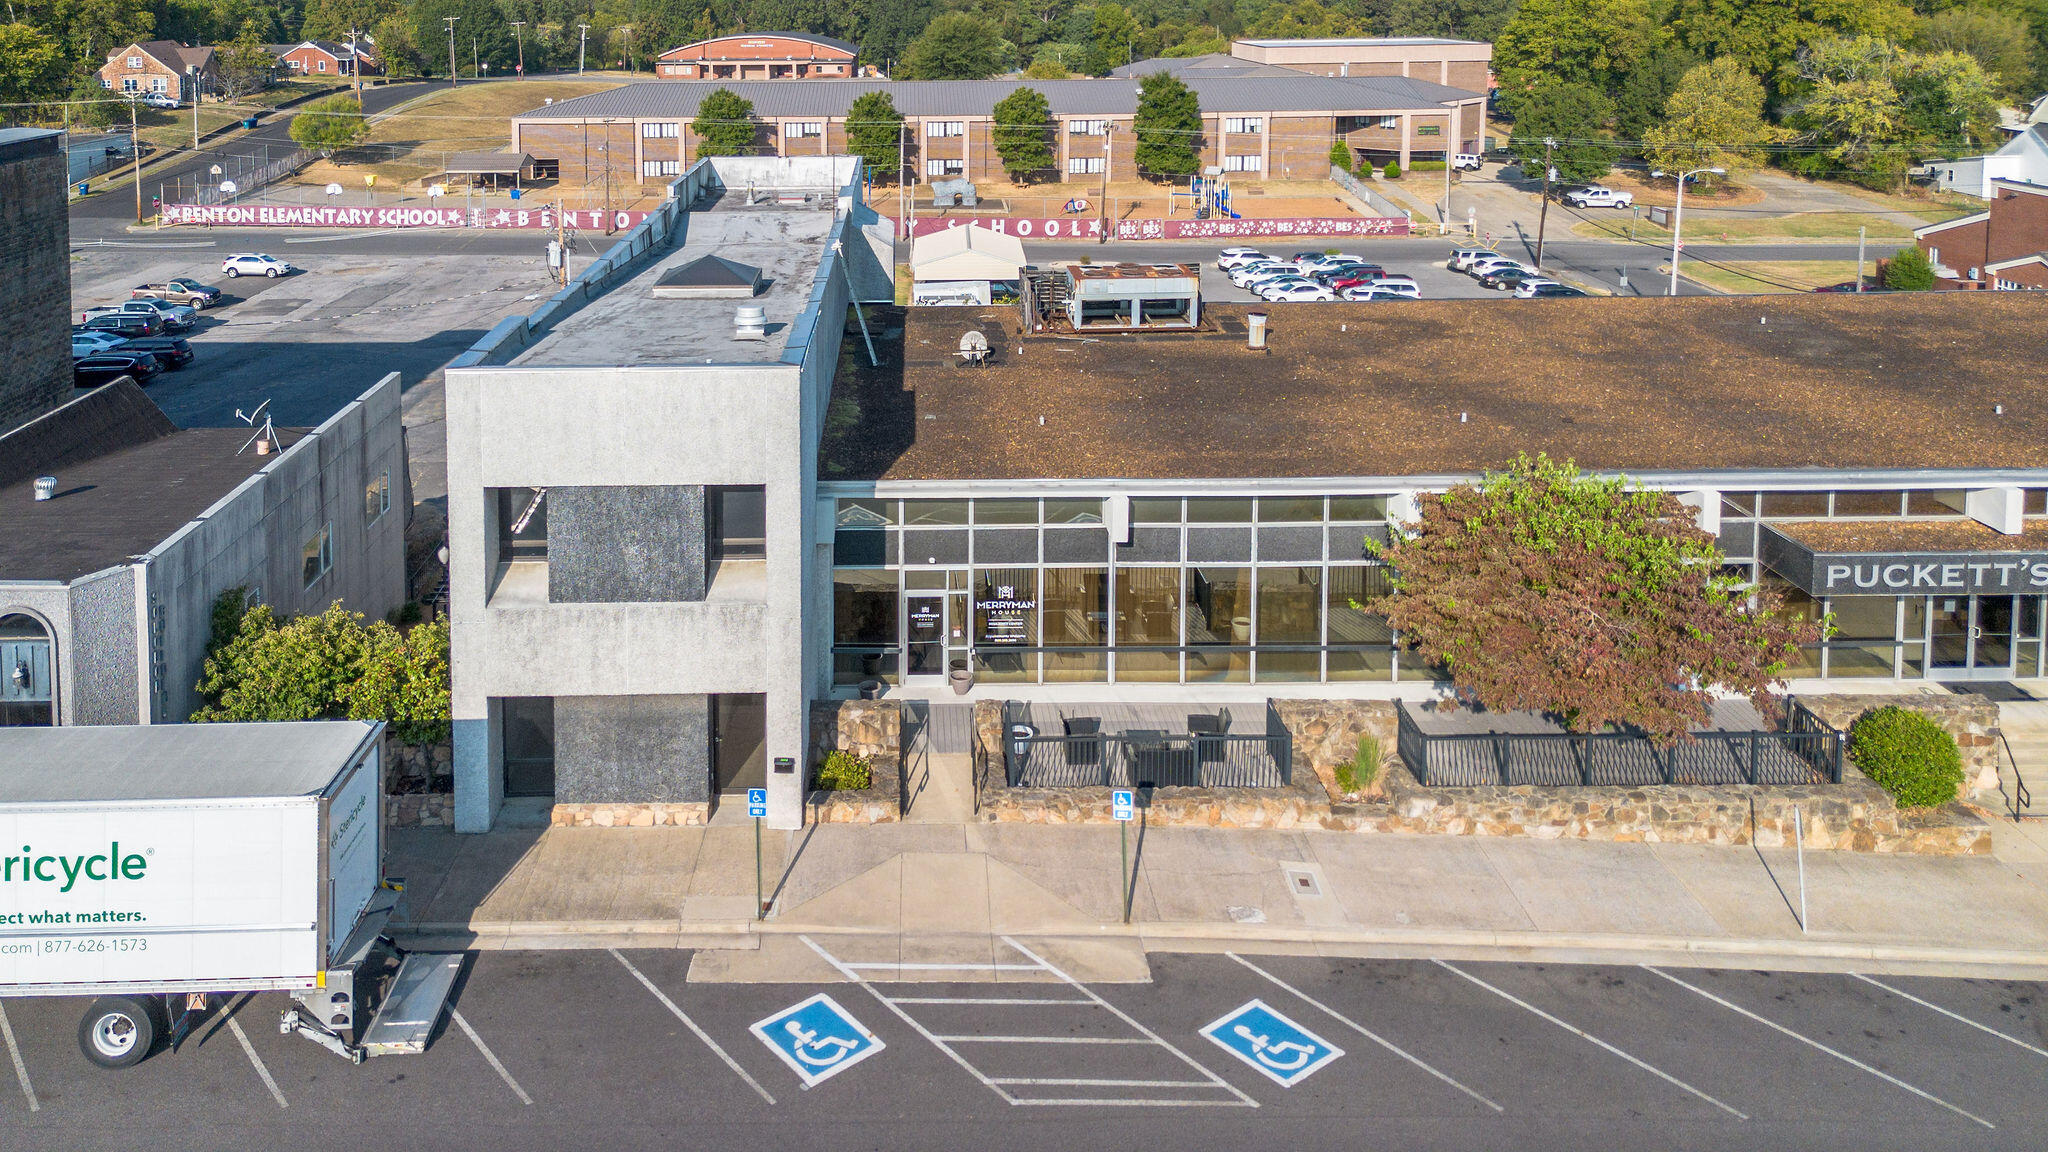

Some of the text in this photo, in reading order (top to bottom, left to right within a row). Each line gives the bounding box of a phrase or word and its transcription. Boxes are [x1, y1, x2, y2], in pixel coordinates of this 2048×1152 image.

[182, 207, 446, 225] BENTON ELEMENTARY SCHOOL
[517, 210, 649, 229] BENTO
[1277, 222, 1294, 232] BES
[1336, 222, 1353, 232] BES
[1826, 558, 2048, 588] PUCKETT'S
[976, 601, 1035, 610] MERRYMAN
[0, 841, 147, 893] ricycle
[29, 910, 71, 924] what
[76, 910, 147, 923] matters.
[45, 938, 147, 953] 877-626-1573
